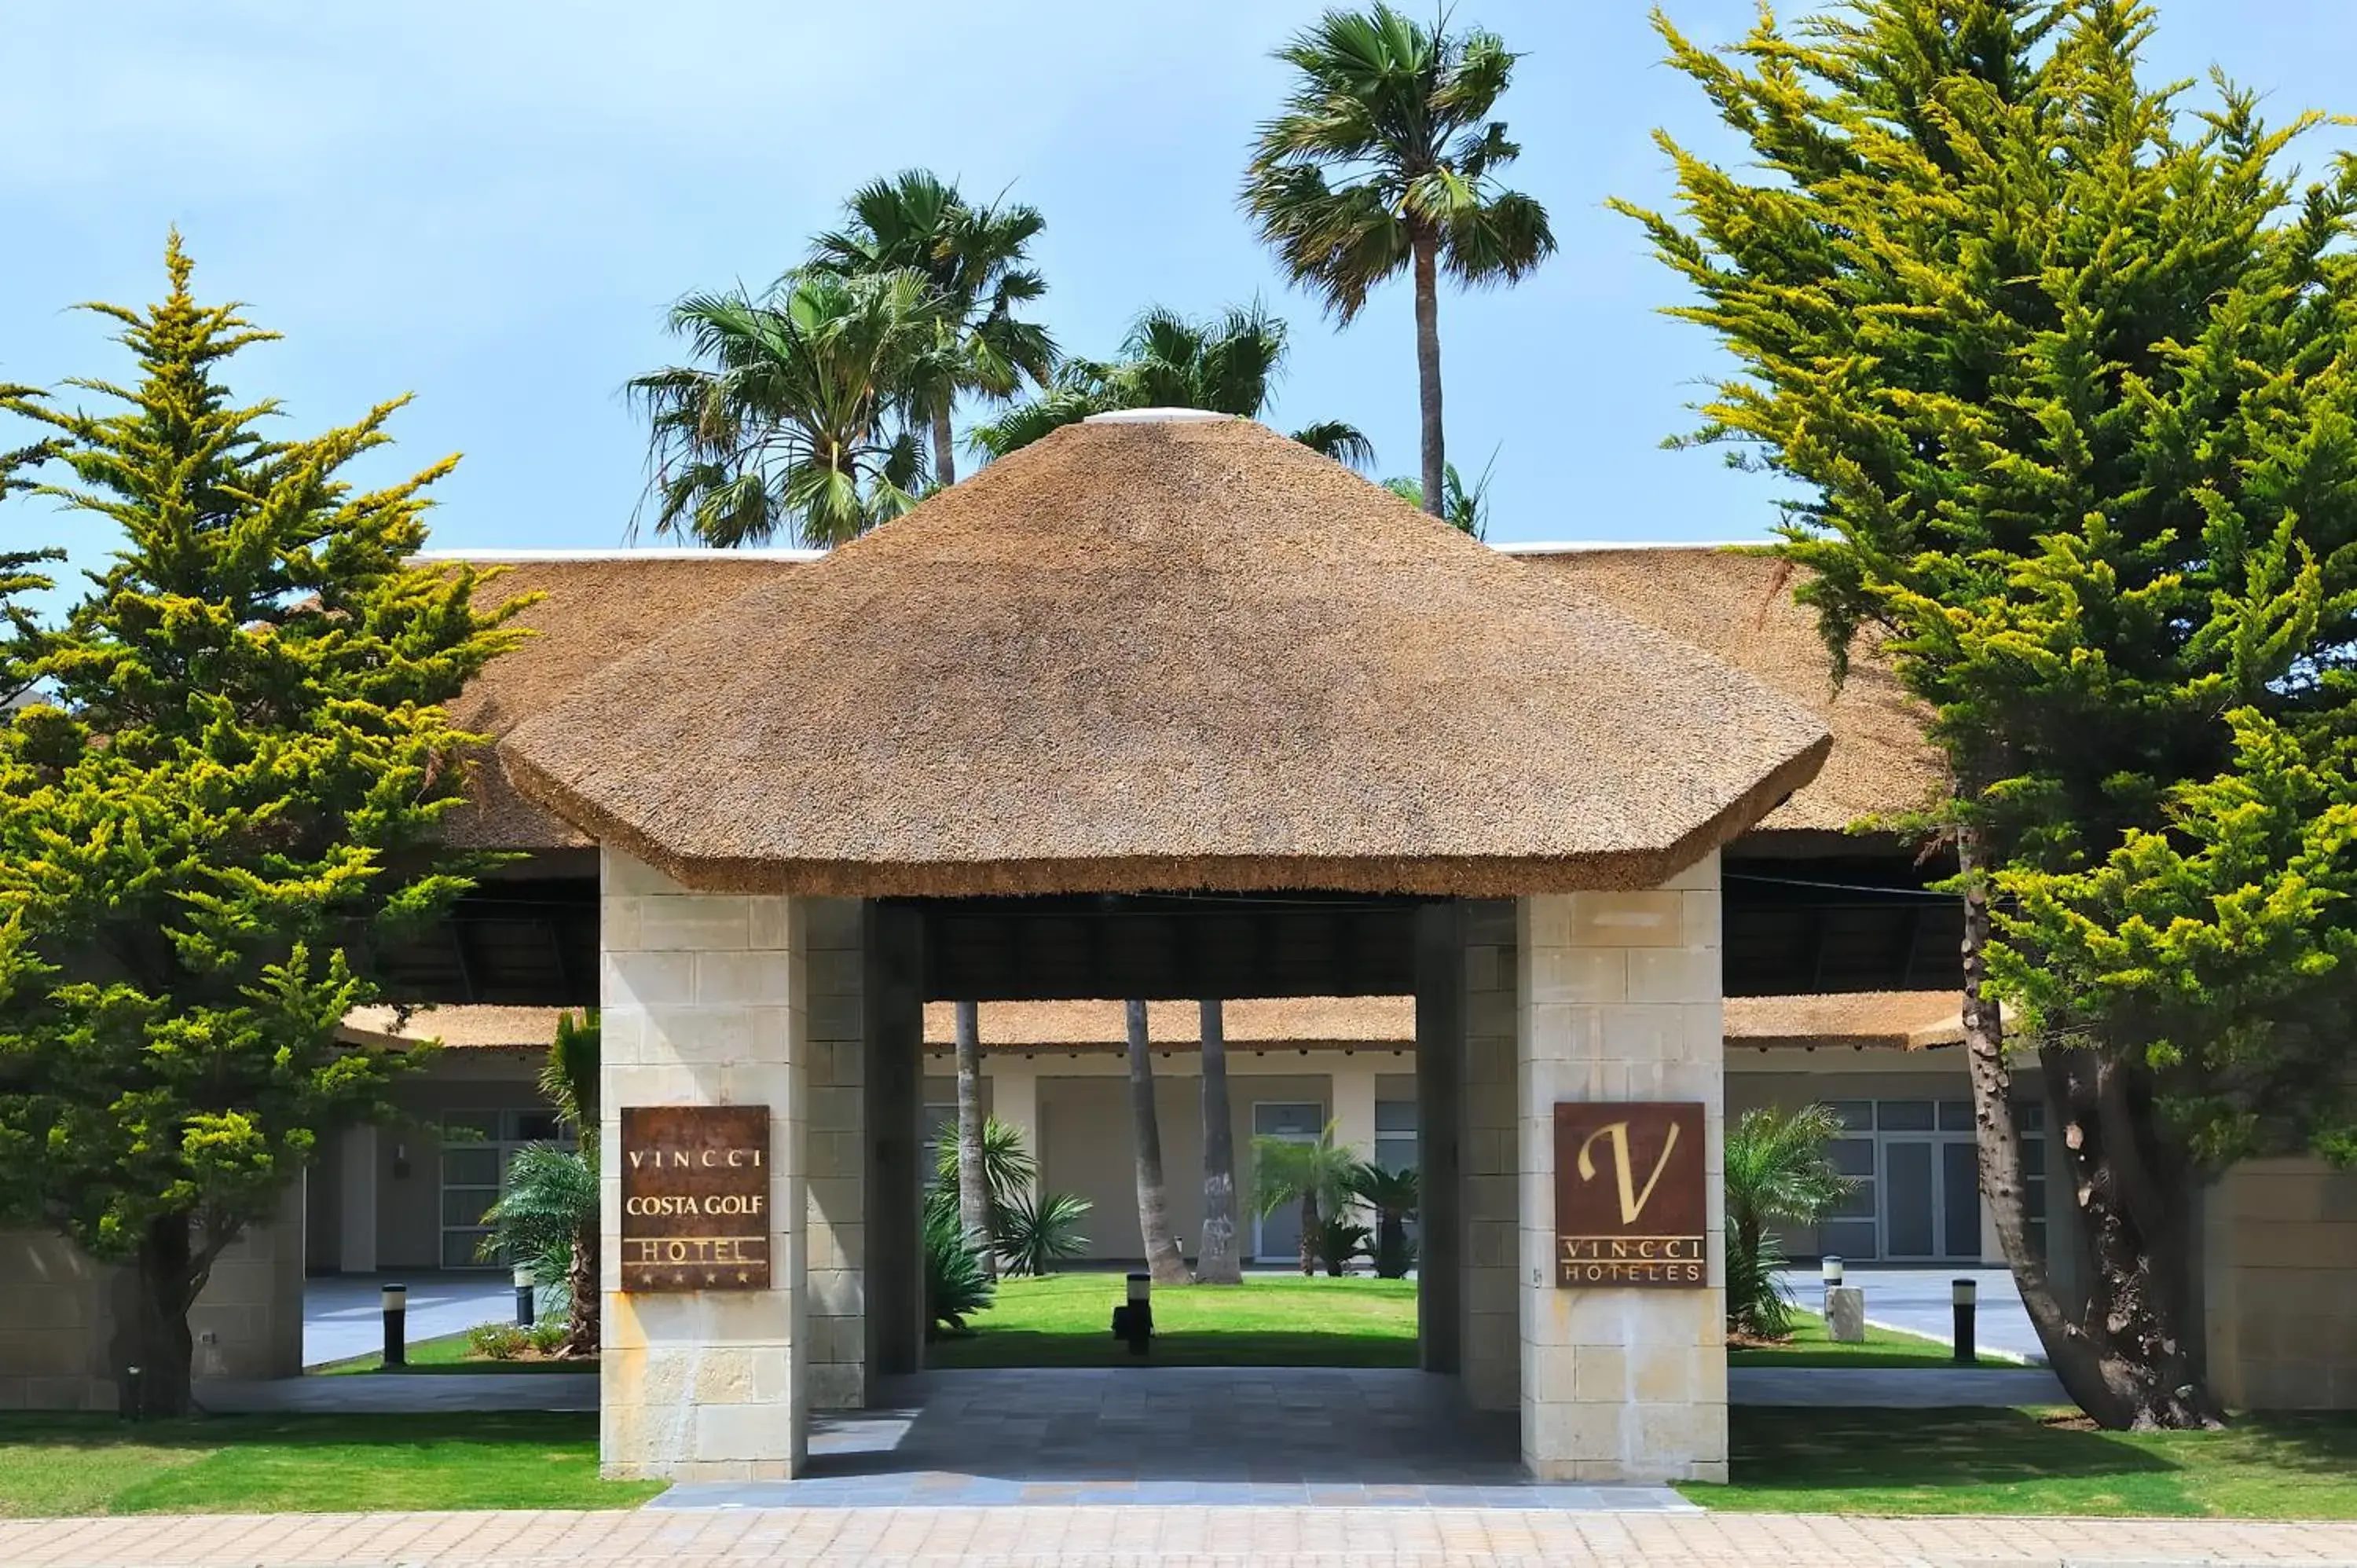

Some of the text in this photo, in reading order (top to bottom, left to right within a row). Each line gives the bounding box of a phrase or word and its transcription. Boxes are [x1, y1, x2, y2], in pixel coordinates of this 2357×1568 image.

[629, 1150, 761, 1168] VINCCI
[1578, 1121, 1680, 1225] V
[627, 1196, 763, 1215] COSTA GOLF
[641, 1240, 747, 1260] HOTEL
[1566, 1241, 1698, 1258] VINCCI
[1566, 1266, 1699, 1281] HOTELES
